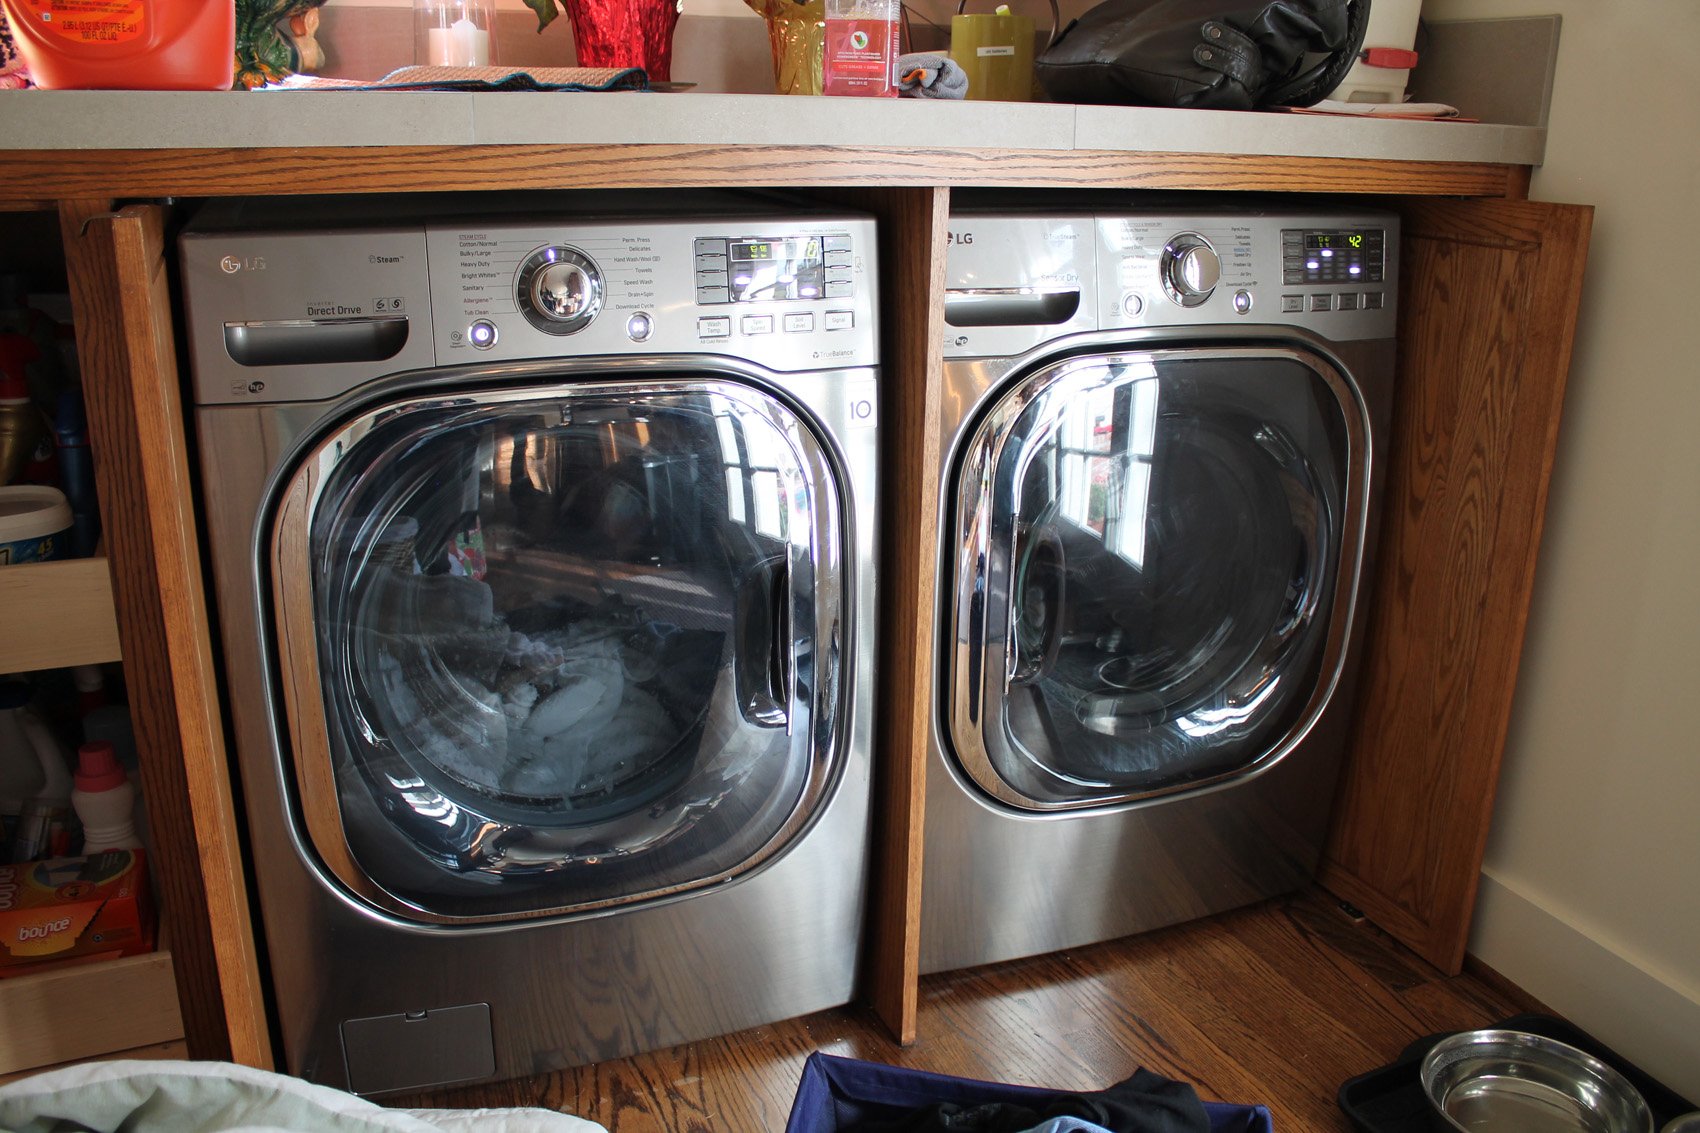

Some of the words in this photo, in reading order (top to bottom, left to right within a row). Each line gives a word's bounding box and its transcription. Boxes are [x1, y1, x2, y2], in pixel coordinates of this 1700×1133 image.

[81, 30, 90, 40] 100
[100, 32, 108, 40] OZ
[956, 233, 972, 245] LG
[1349, 235, 1362, 247] 42
[244, 257, 267, 271] LG
[1066, 274, 1079, 282] Dry
[307, 306, 335, 316] Direct
[337, 305, 362, 315] Drive
[850, 400, 872, 420] 10
[18, 917, 70, 941] bounce
